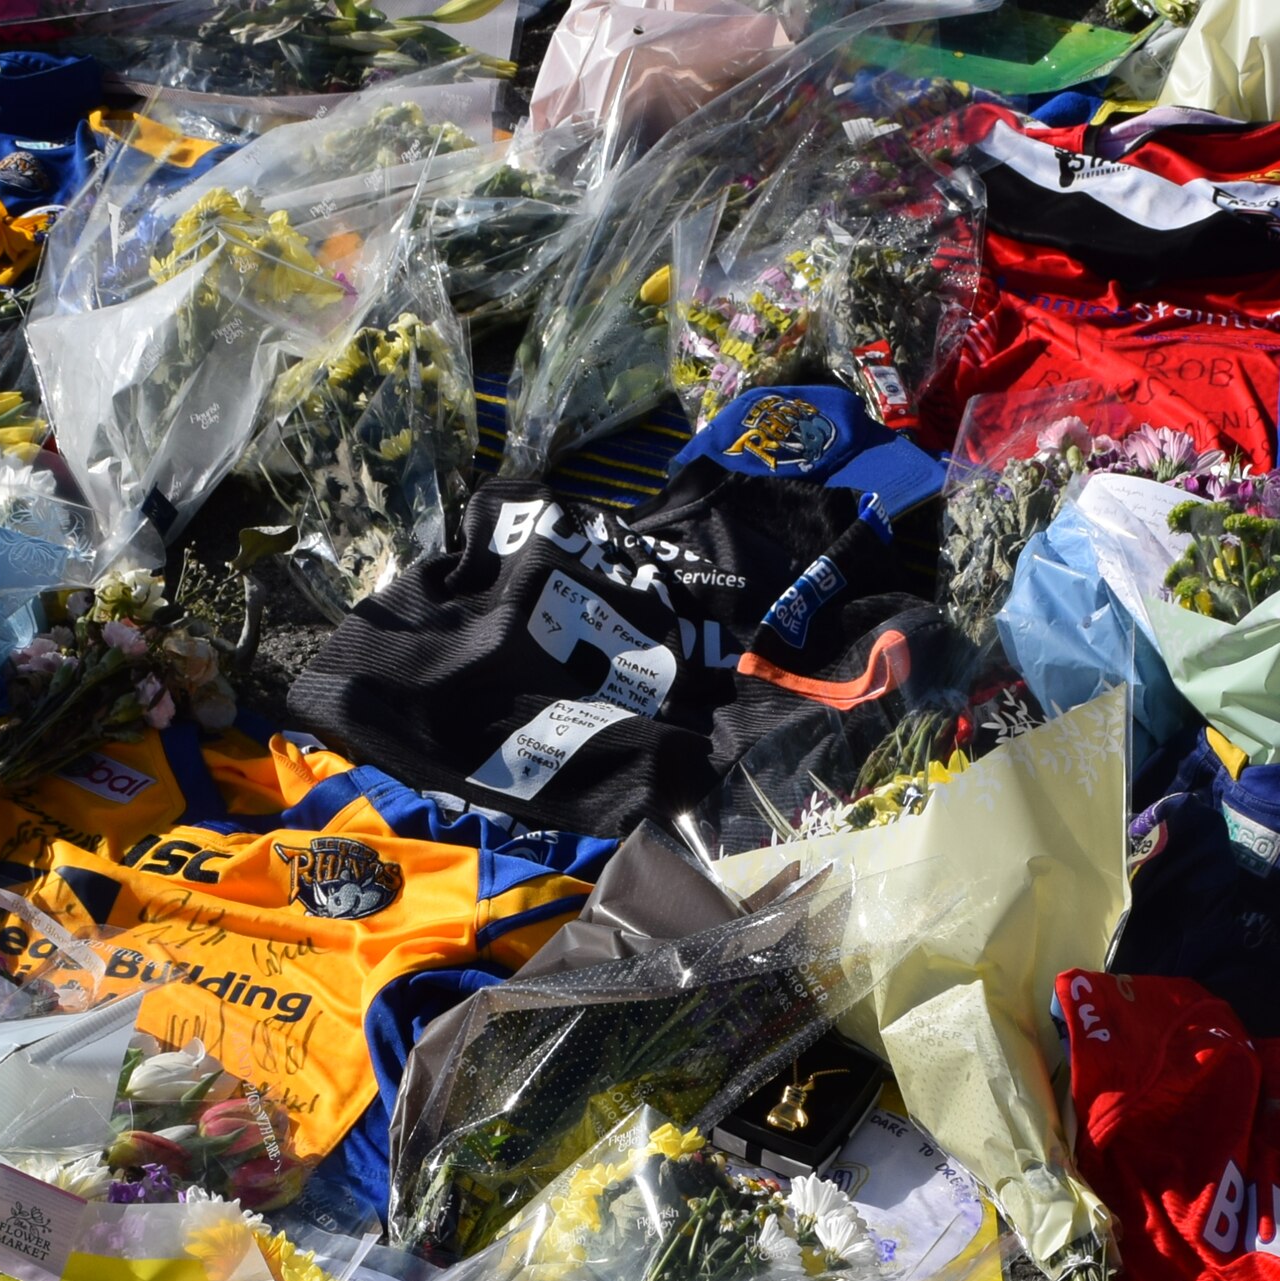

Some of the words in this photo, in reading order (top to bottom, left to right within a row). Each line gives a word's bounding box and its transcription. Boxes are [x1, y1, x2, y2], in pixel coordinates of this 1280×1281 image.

[673, 568, 746, 589] Services
[541, 611, 563, 634] #7
[553, 580, 587, 606] REST
[594, 606, 609, 621] IN
[613, 625, 651, 651] PEACE
[580, 611, 604, 632] ROB
[617, 656, 660, 680] THANK
[607, 683, 624, 695] ALL
[628, 690, 650, 708] THE
[614, 670, 634, 687] YOU
[636, 682, 658, 699] FOR
[549, 712, 596, 729] LEGEND
[516, 733, 568, 761] GEORGIA
[124, 833, 237, 884] ISC
[869, 1113, 905, 1139] DARE
[917, 1141, 936, 1159] TO
